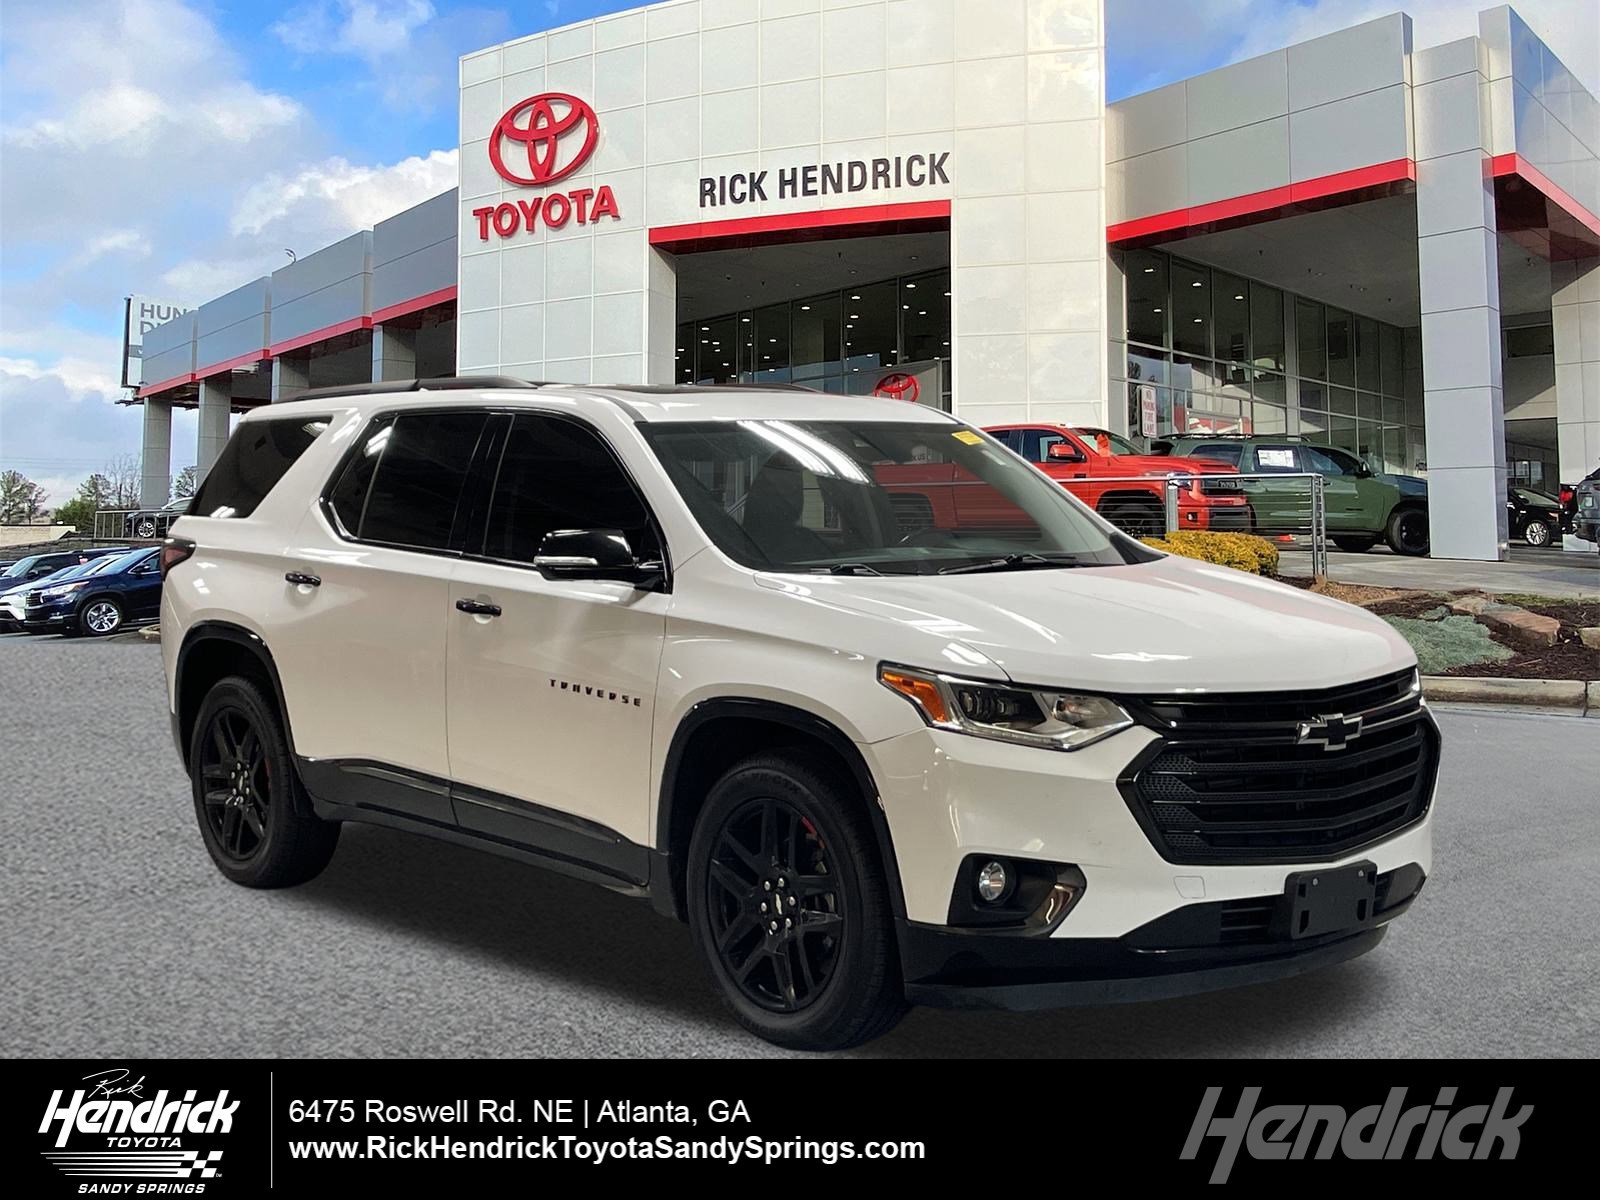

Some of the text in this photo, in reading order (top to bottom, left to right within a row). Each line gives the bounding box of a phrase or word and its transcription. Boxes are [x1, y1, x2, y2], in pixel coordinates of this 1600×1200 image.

[699, 152, 950, 208] RICK HENDRICK
[473, 185, 620, 240] TOYOTA
